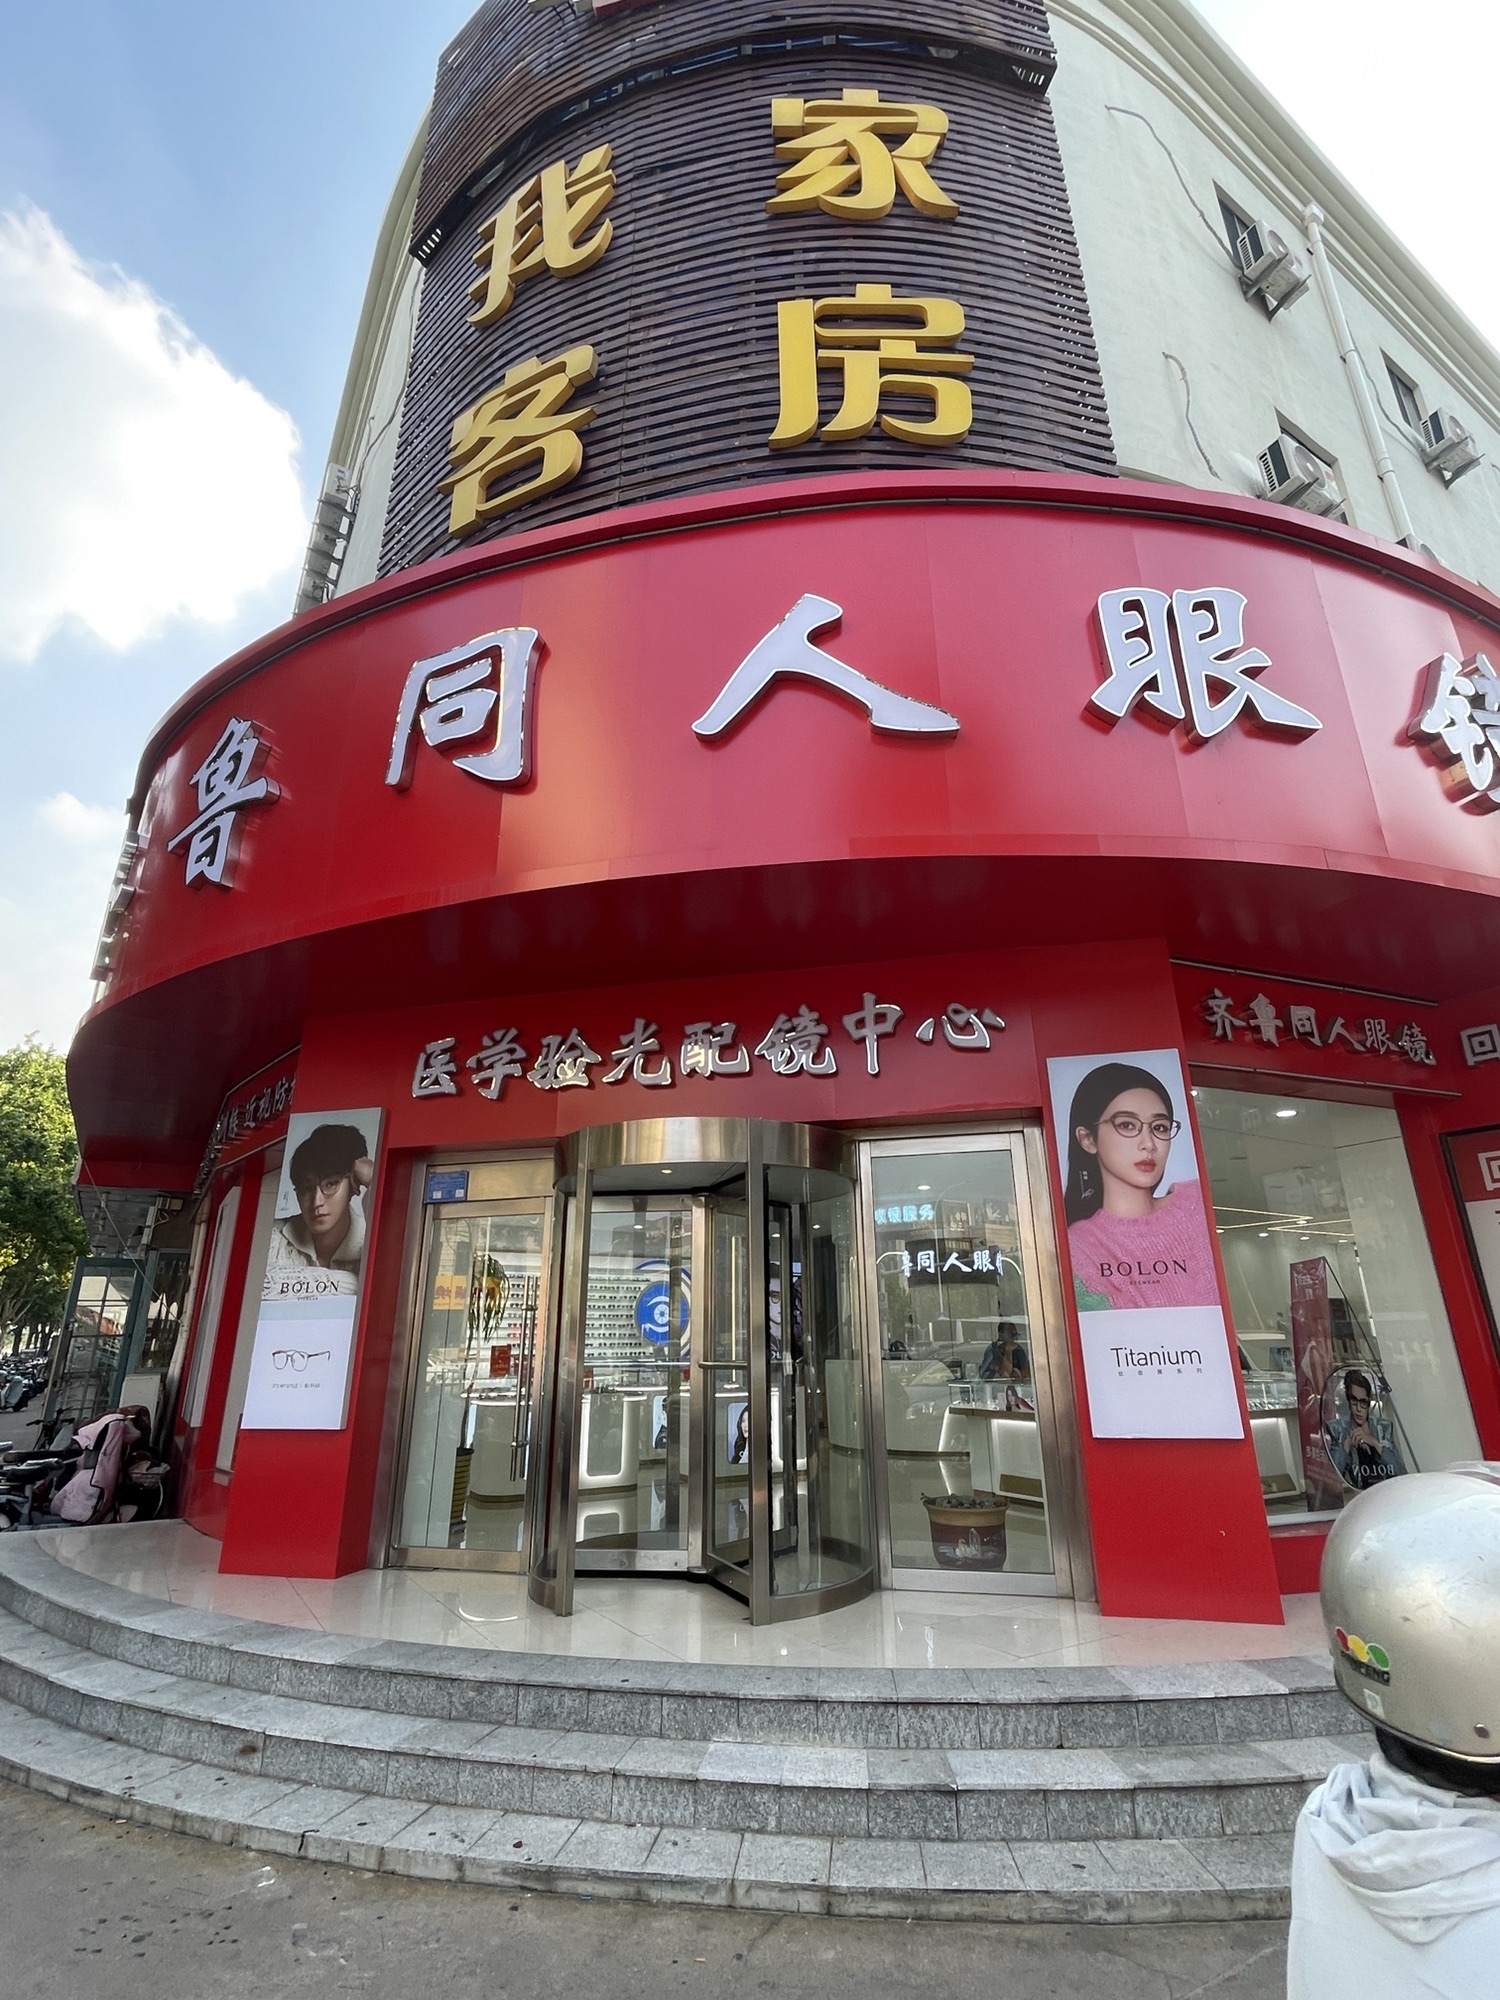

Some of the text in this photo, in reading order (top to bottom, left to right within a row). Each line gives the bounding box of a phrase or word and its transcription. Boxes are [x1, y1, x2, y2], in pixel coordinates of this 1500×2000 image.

[1204, 988, 1438, 1066] 齐鲁同人眼镜
[411, 991, 1006, 1100] 医学验光配镜中心
[1099, 1259, 1188, 1278] BOLON
[279, 1281, 340, 1295] BOLON
[1110, 1345, 1202, 1368] Titanium
